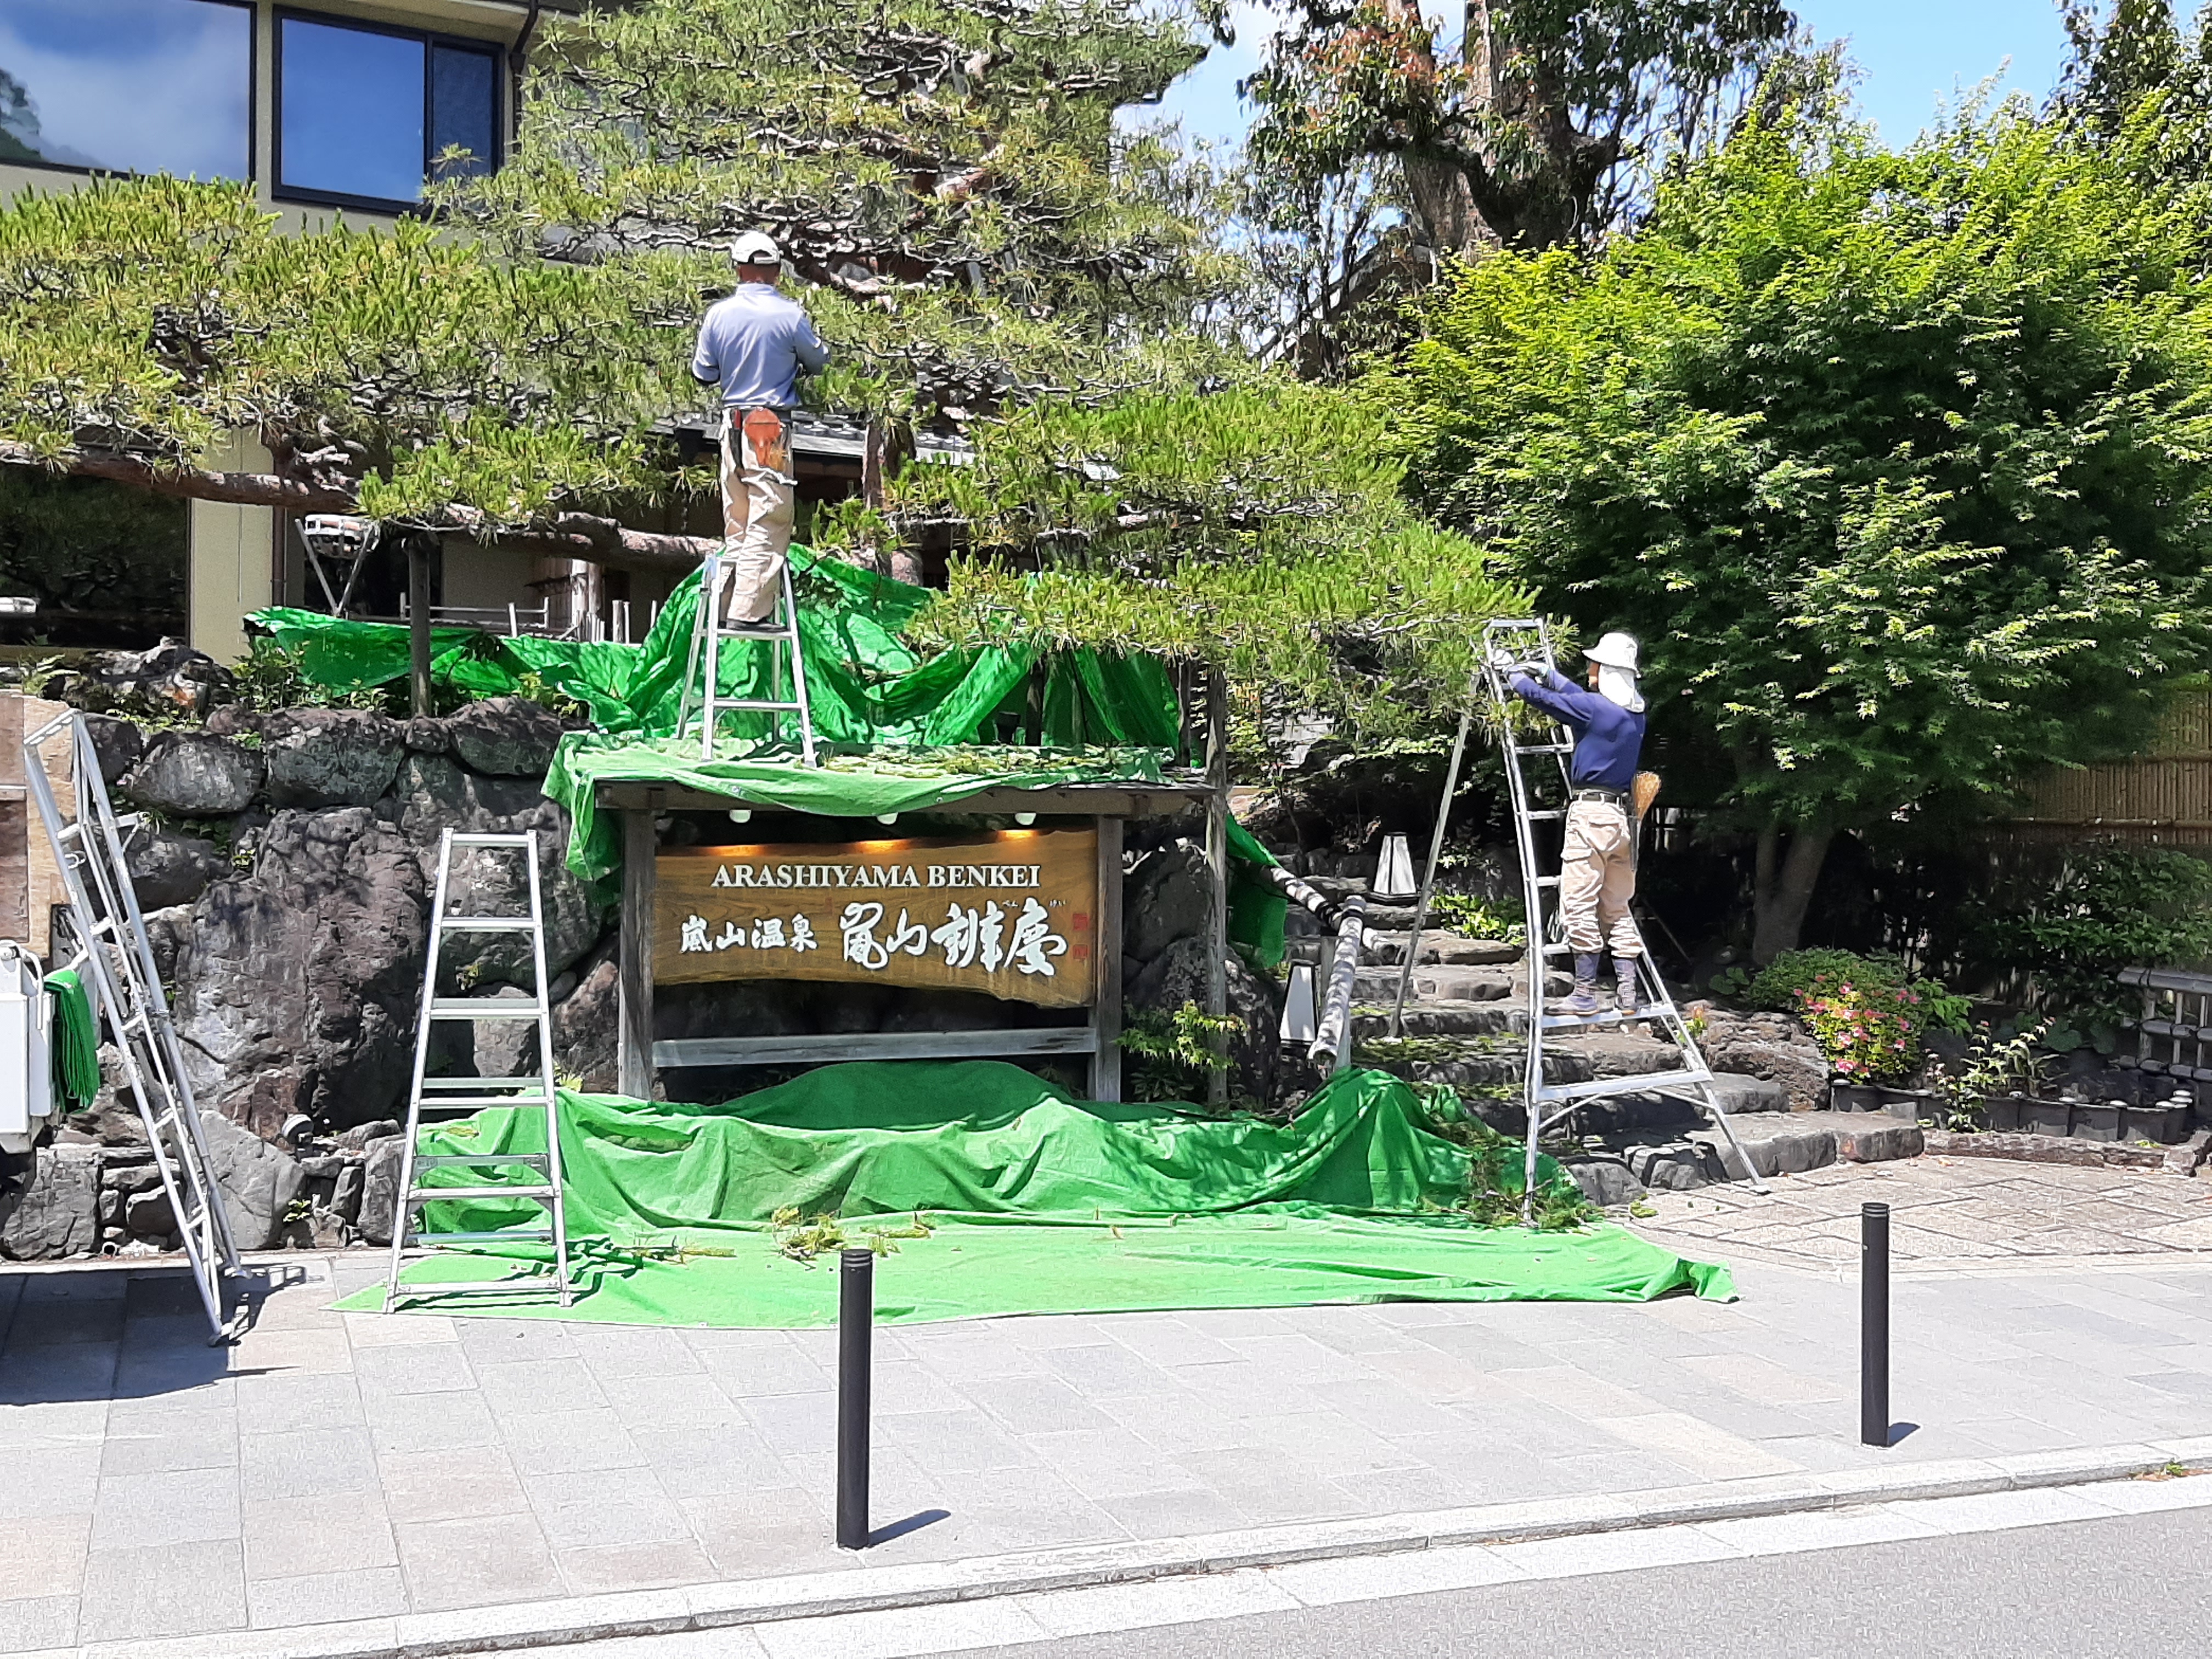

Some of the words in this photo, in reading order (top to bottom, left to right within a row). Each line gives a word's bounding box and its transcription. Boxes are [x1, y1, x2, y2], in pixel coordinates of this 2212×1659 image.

[710, 864, 921, 888] ARASHIYAMA
[927, 865, 1041, 888] BENKEI
[680, 914, 818, 953] 嵐山温泉
